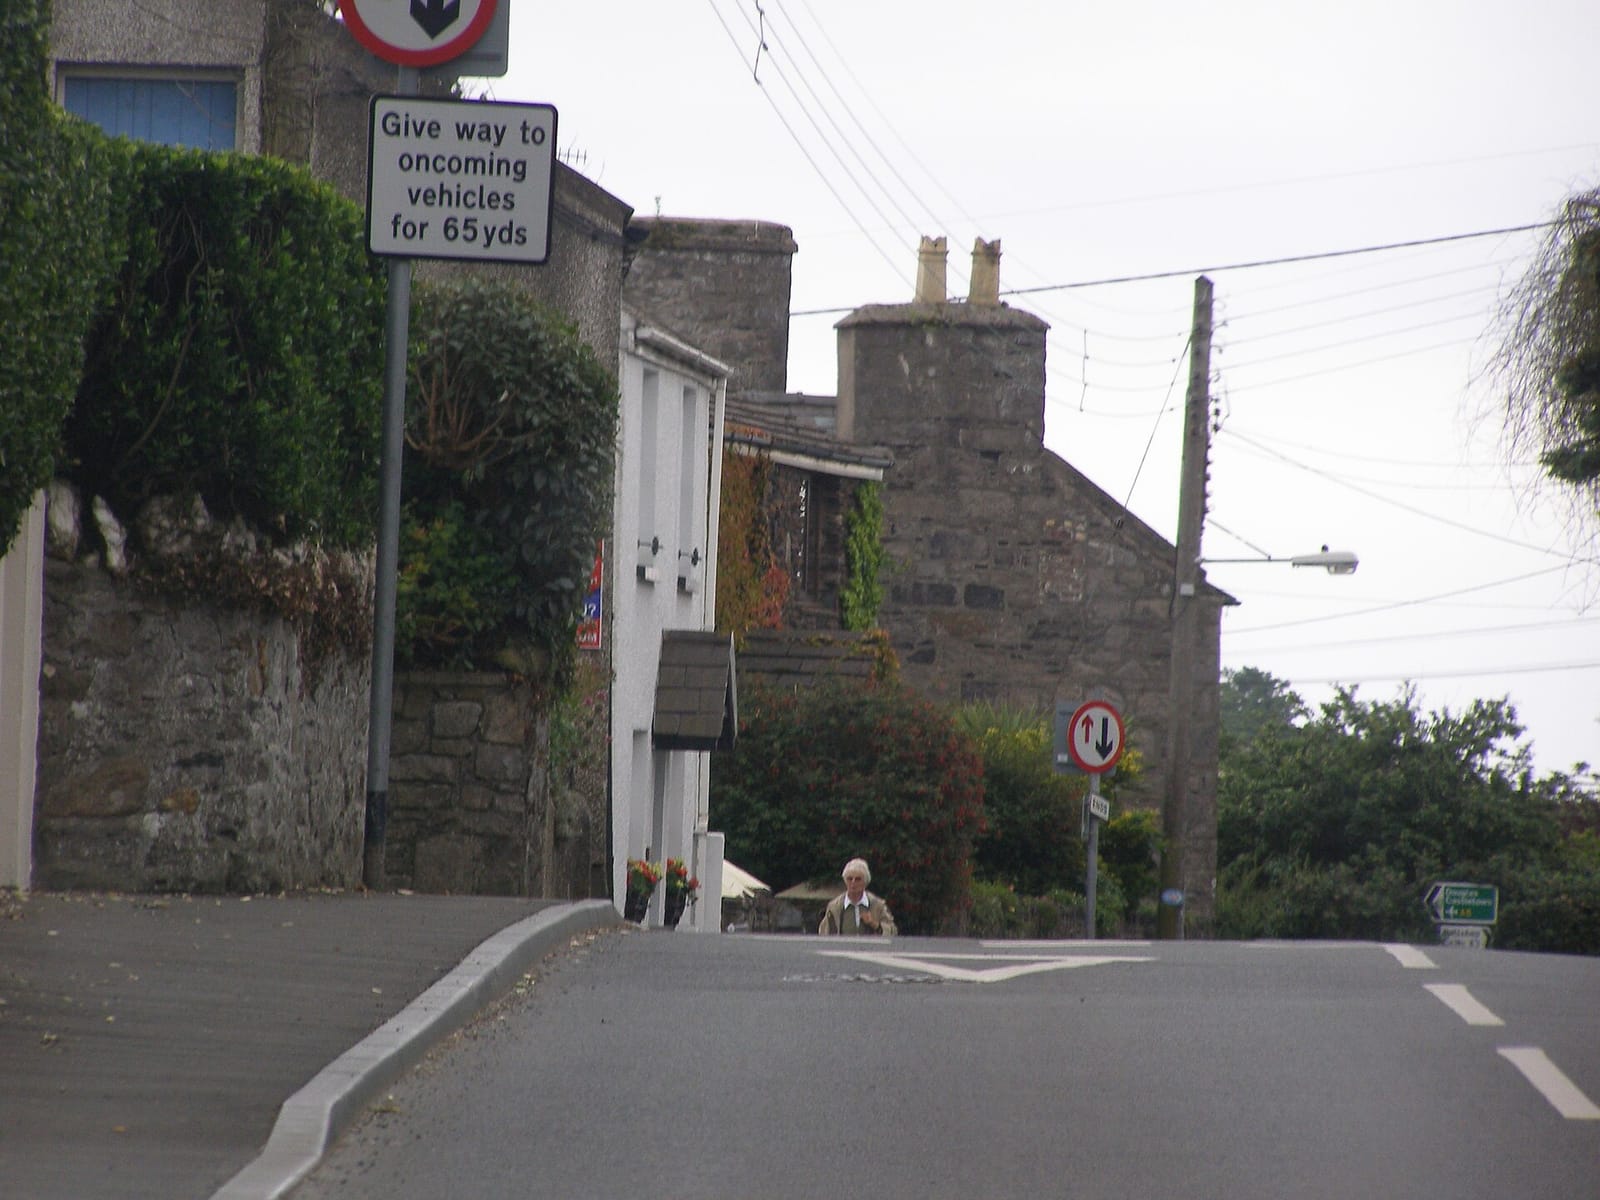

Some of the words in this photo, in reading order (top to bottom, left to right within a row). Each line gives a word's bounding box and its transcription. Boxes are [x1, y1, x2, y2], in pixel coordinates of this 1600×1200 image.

[381, 111, 441, 139] Give
[455, 121, 507, 147] way
[520, 120, 546, 146] to
[398, 152, 527, 183] oncoming
[407, 182, 516, 211] vehicles
[391, 213, 429, 241] for
